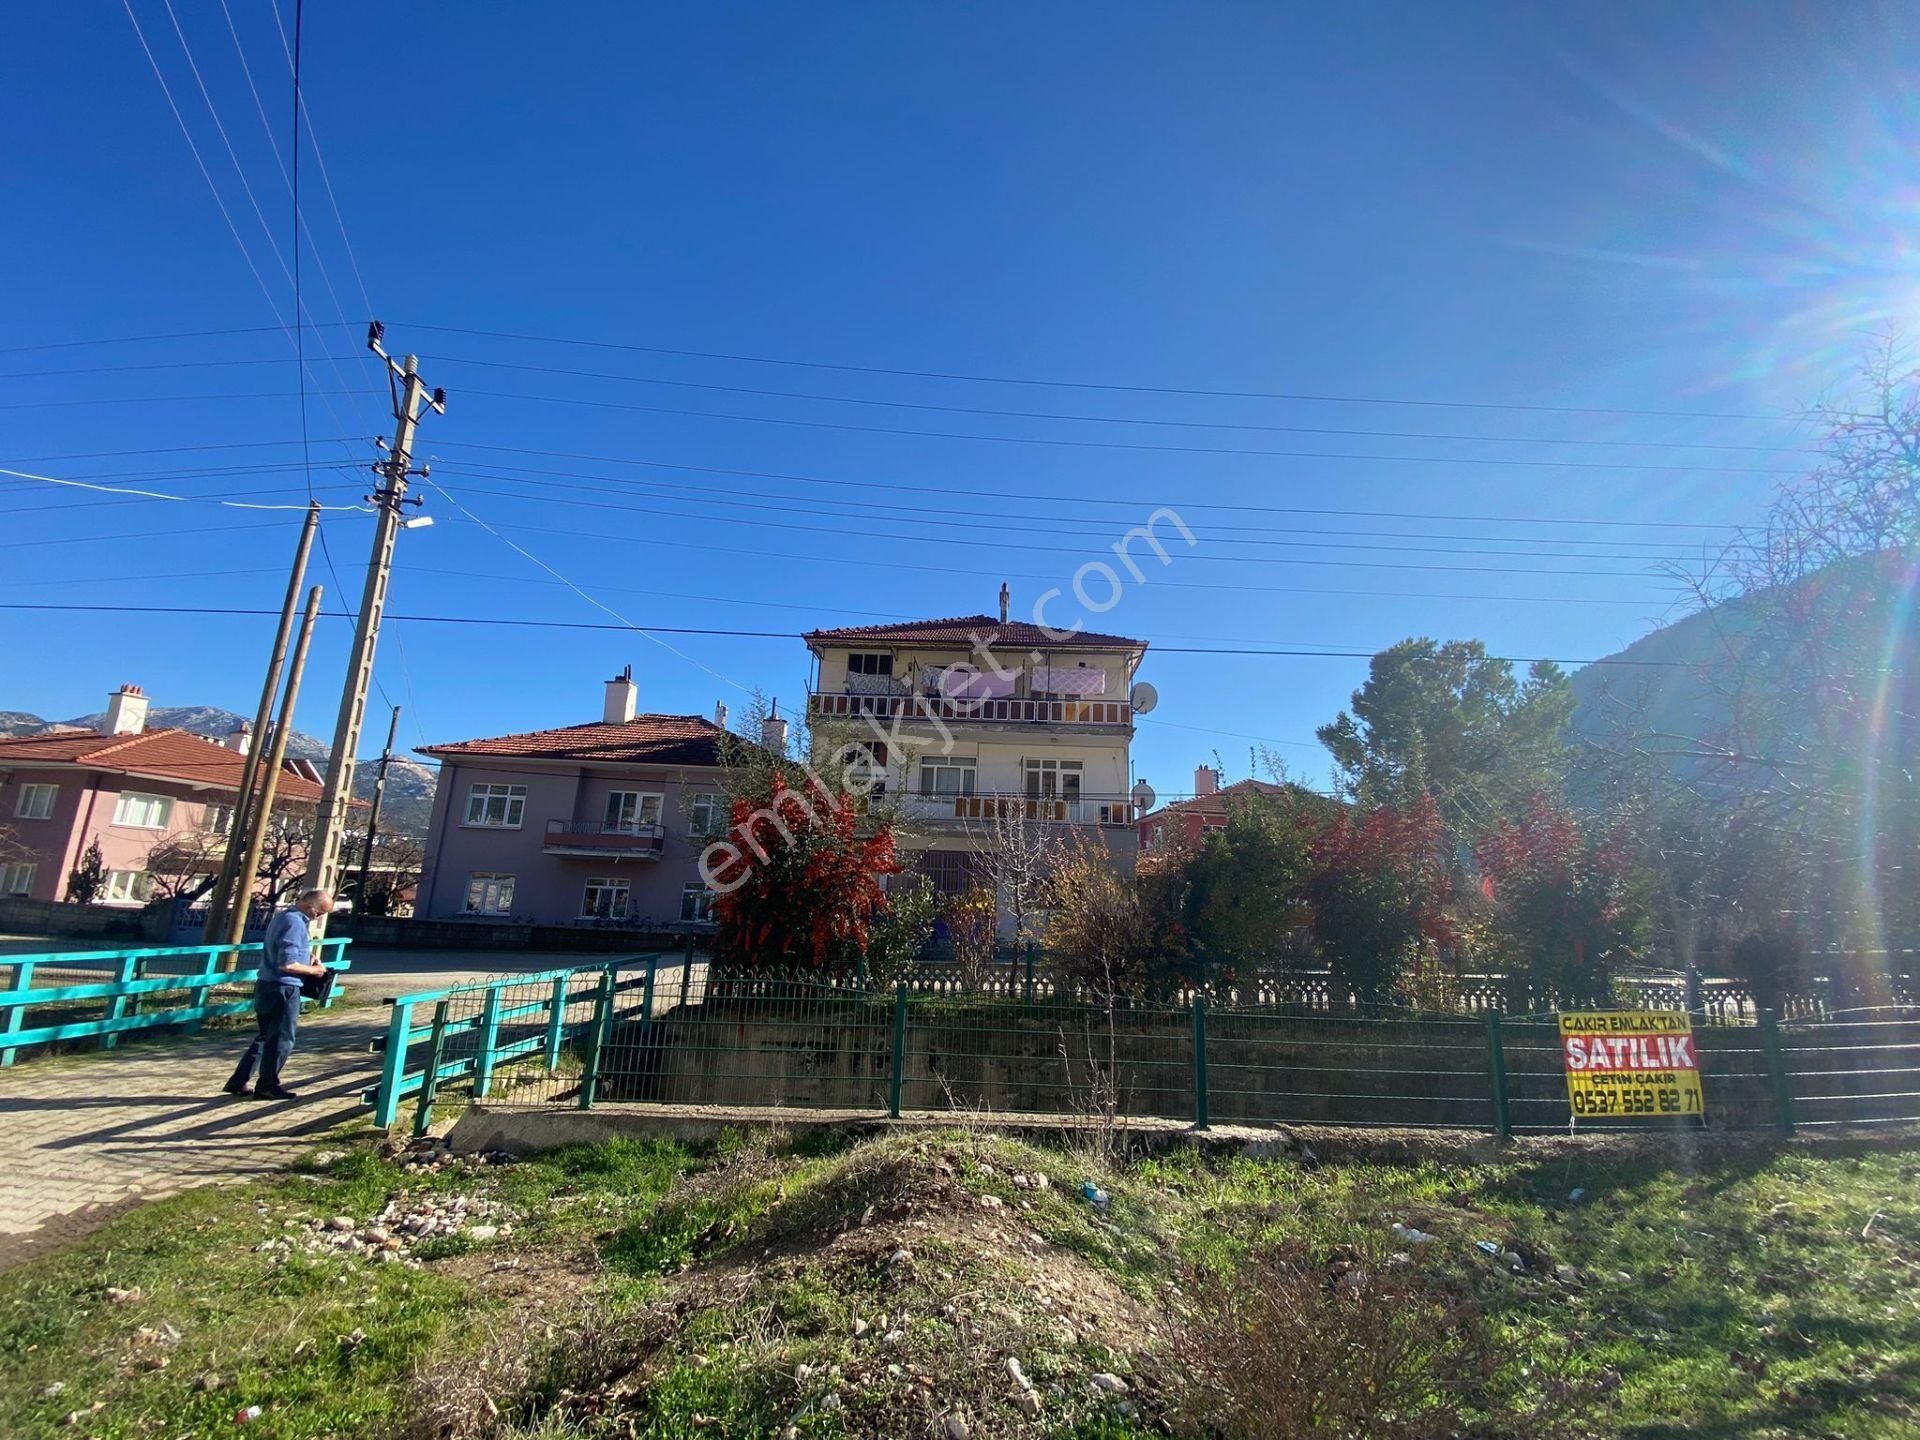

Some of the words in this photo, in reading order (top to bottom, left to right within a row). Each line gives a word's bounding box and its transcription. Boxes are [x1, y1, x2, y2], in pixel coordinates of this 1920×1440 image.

[1566, 1036, 1694, 1069] SATILIK
[1573, 1090, 1617, 1114] 0537
[1622, 1089, 1655, 1113] 552
[1685, 1088, 1701, 1112] 71
